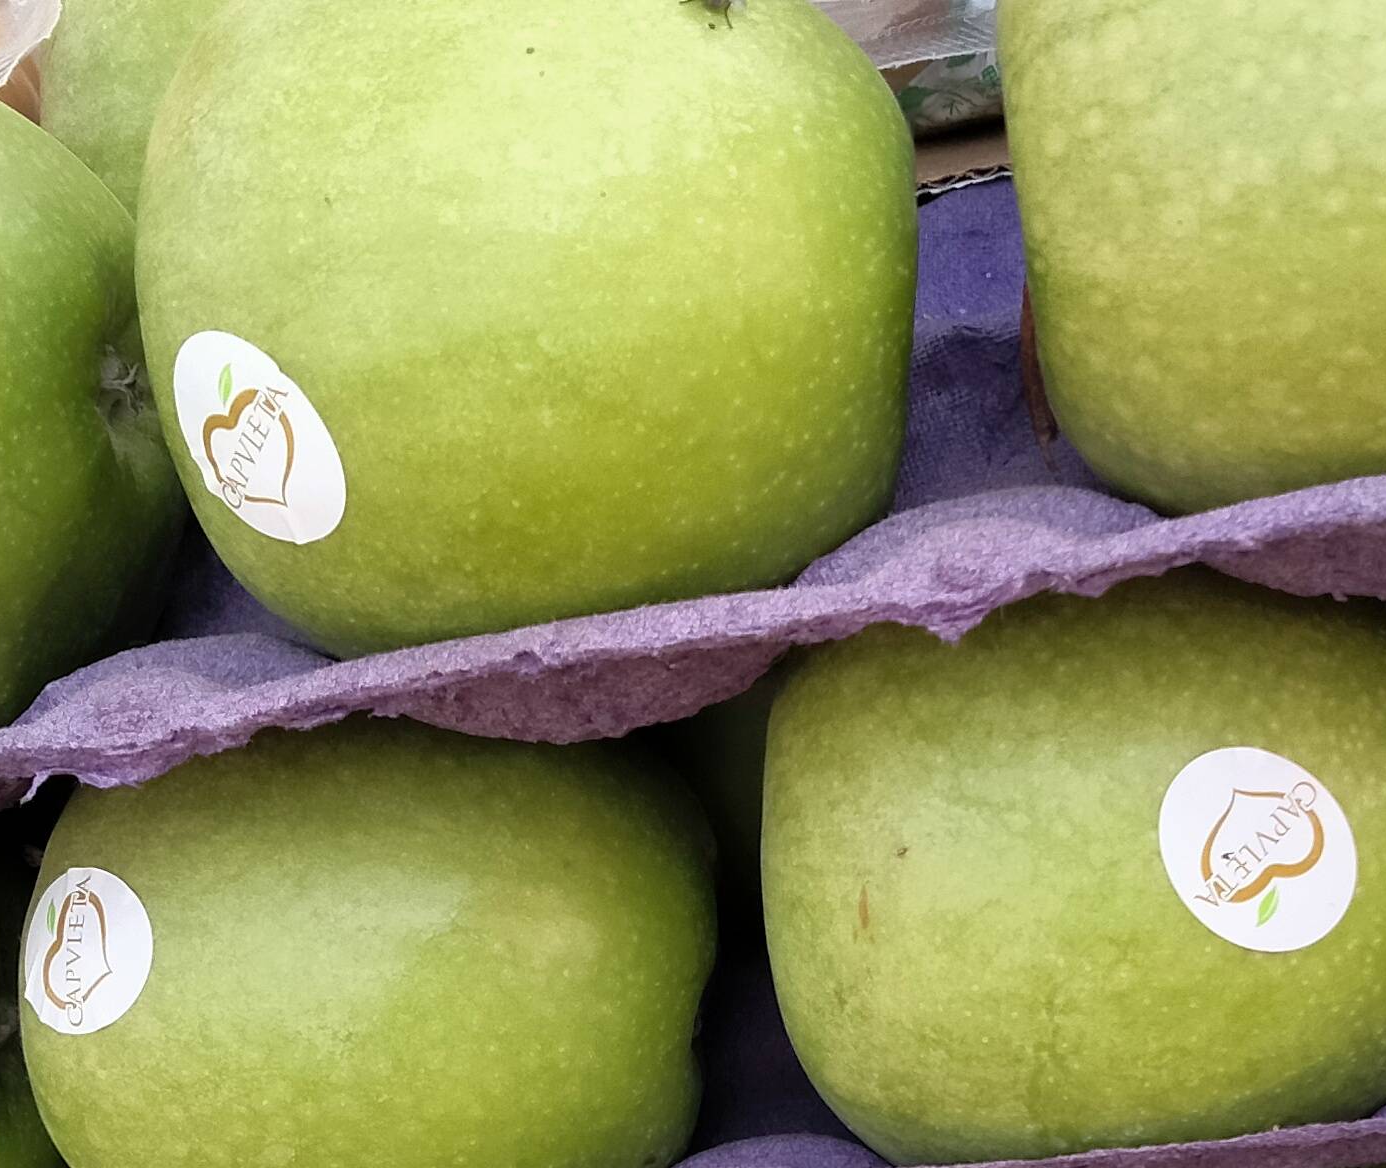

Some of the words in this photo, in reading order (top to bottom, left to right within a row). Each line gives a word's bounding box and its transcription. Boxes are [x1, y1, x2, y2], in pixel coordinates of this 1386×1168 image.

[220, 386, 289, 510] CAPVLETA
[1193, 781, 1317, 908] CAPVLETA
[66, 875, 93, 1027] CAPVLETA
